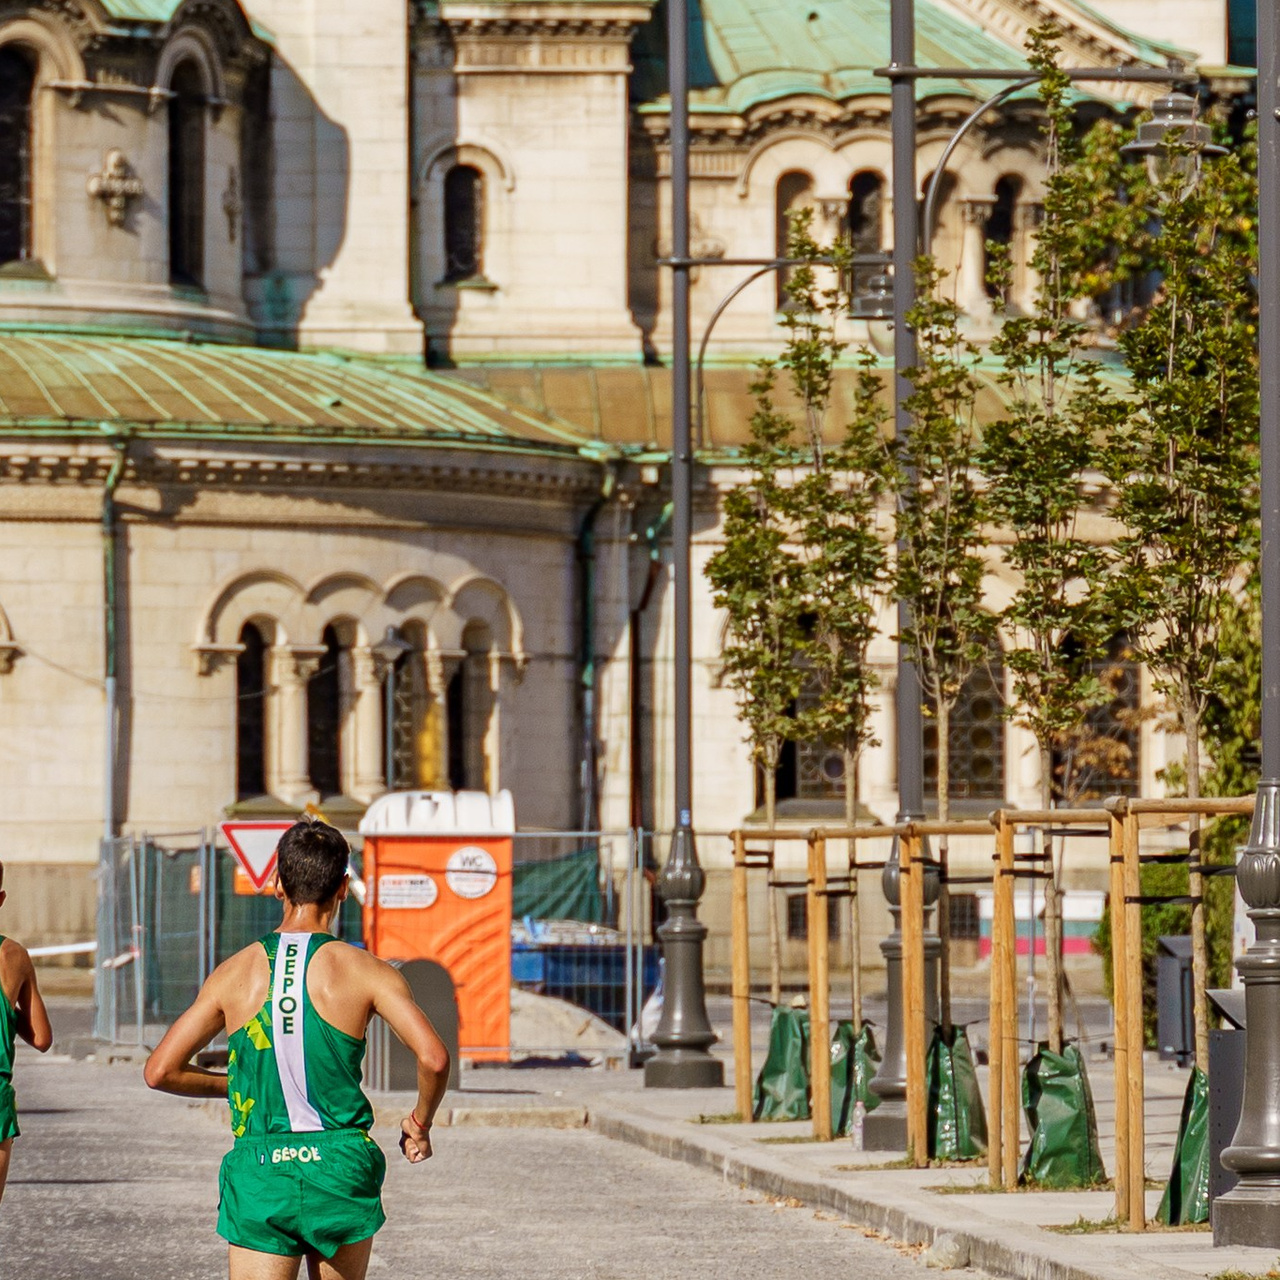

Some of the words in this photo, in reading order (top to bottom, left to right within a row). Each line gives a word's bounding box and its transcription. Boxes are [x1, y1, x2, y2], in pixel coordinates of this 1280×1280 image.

[461, 855, 483, 867] WC
[278, 944, 298, 1034] БЕРОЕ
[271, 1146, 322, 1164] БЕРОЕ
